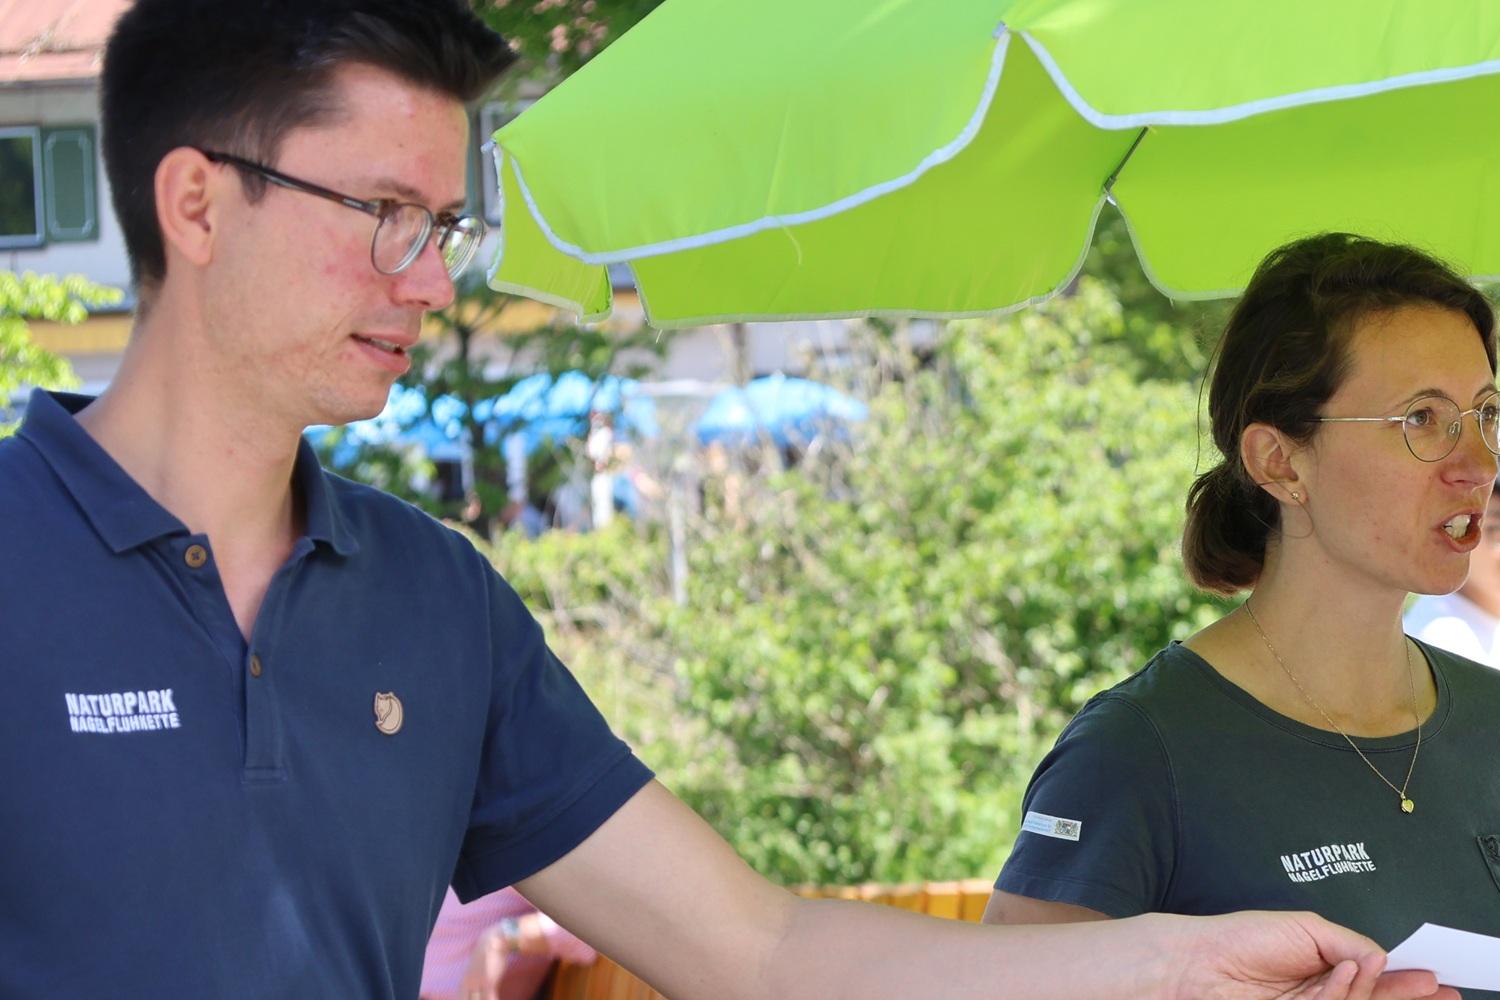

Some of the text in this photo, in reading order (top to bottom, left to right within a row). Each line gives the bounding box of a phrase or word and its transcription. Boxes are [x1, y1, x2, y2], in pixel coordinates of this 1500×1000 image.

[64, 688, 177, 717] NATURPARK
[69, 712, 181, 733] NAGELFLUHKETTE
[1280, 842, 1370, 873] NATURPARK
[1287, 860, 1377, 883] NAGELFLUHKETTE
